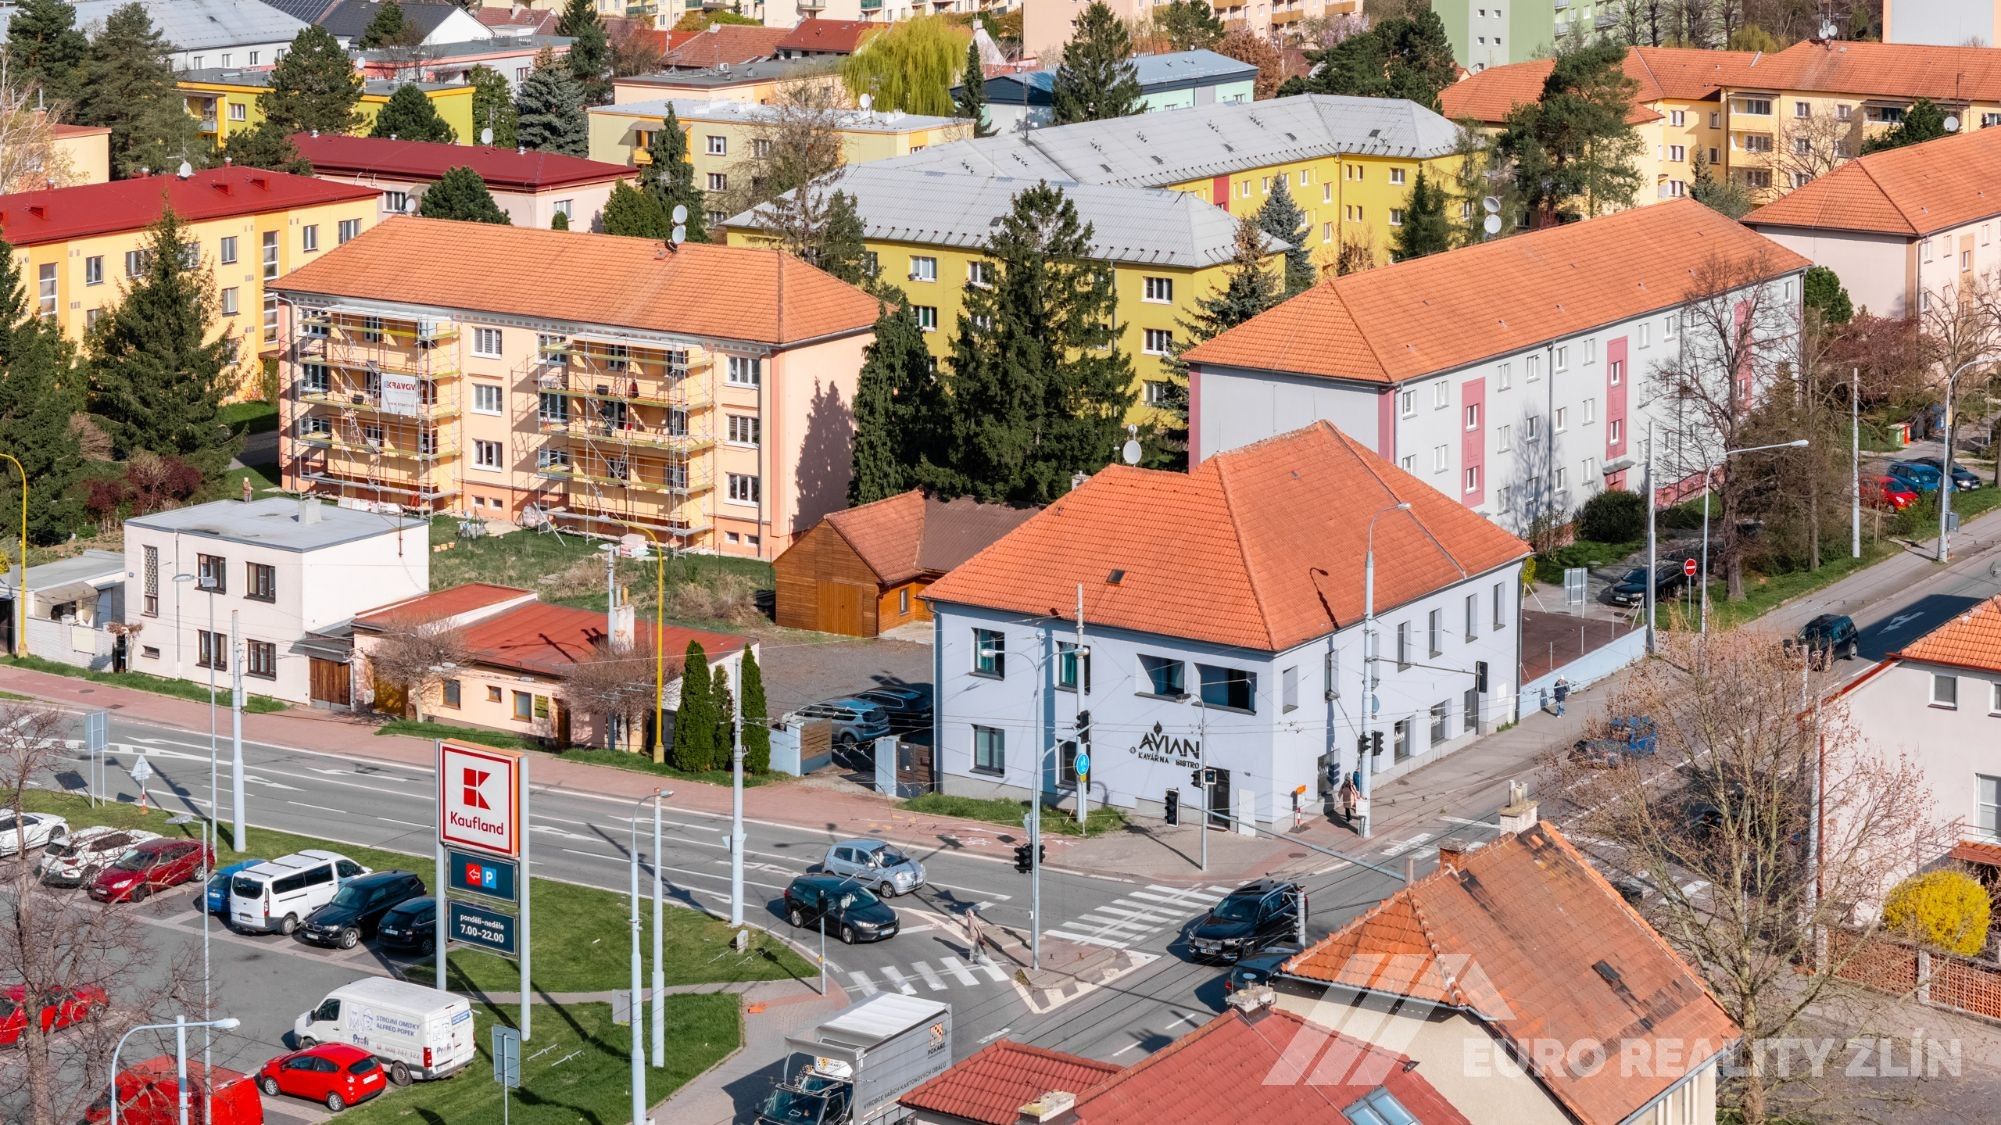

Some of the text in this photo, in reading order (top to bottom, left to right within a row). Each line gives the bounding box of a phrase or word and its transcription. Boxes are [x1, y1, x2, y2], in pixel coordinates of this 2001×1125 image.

[1139, 732, 1200, 759] AVIAN
[1138, 752, 1200, 769] KAVÁRNA BISTRO
[450, 811, 504, 836] Kaufland
[460, 924, 504, 944] 7.00-22.00
